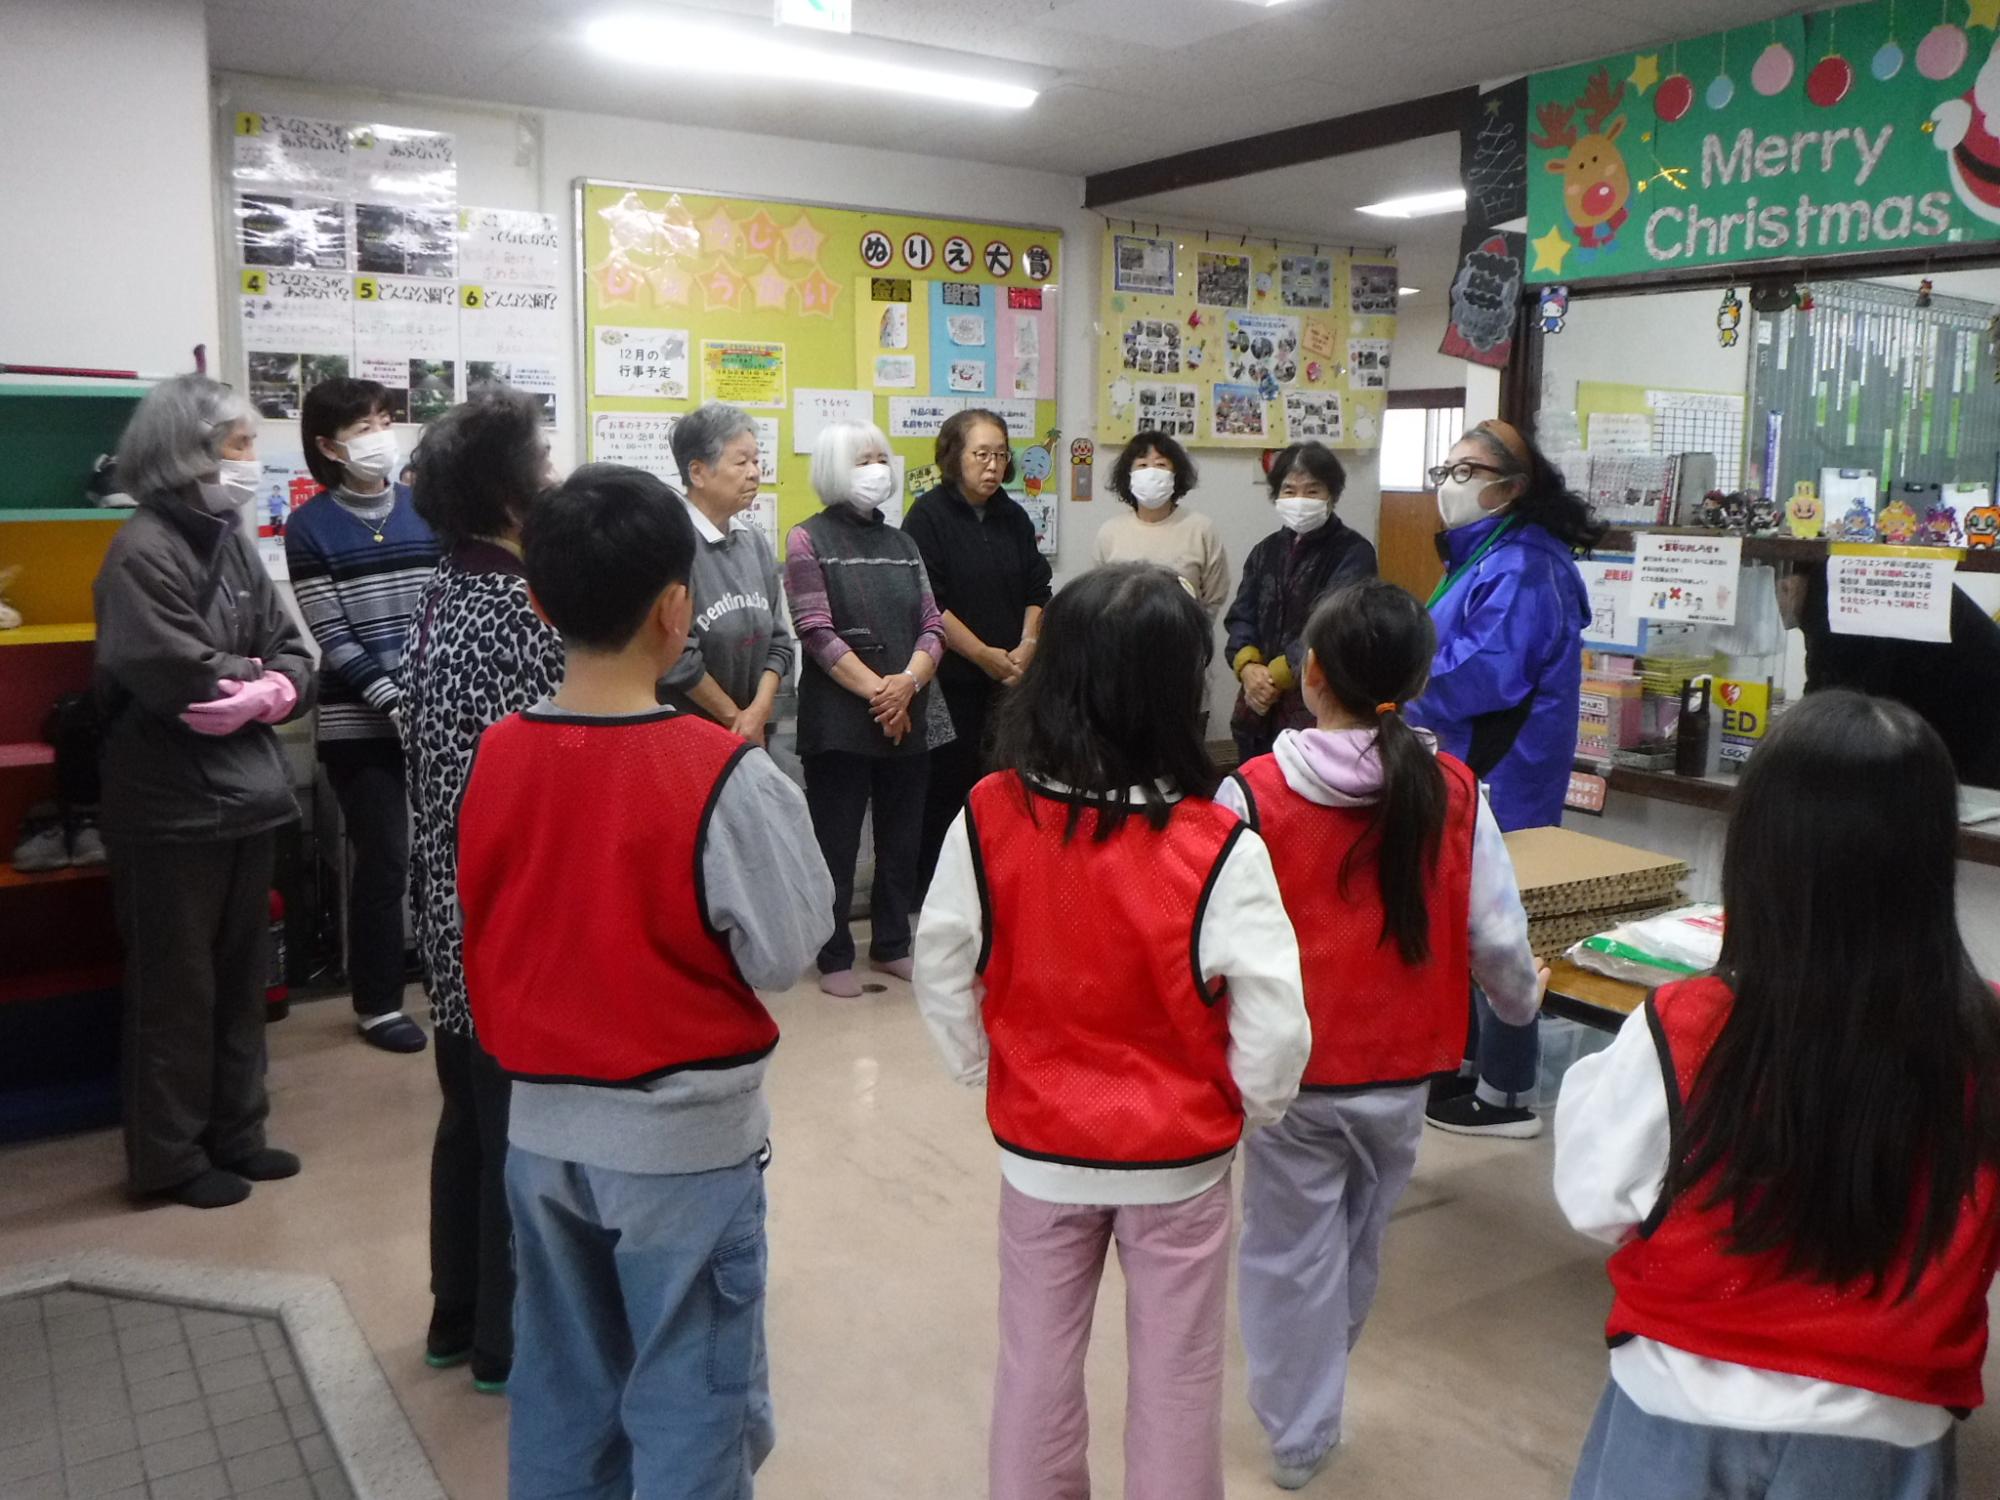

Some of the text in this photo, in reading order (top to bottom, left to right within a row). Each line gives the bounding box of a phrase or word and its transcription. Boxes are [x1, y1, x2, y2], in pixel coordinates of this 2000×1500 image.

[1701, 124, 1893, 190] Merry
[1644, 191, 1952, 261] Christmas
[864, 236, 1051, 277] ぬりえ大賞
[247, 275, 260, 292] 4
[360, 283, 373, 299] 5
[466, 291, 479, 307] 6
[619, 348, 660, 362] 12月の
[619, 364, 672, 380] 行事予定
[1722, 708, 1758, 733] ED
